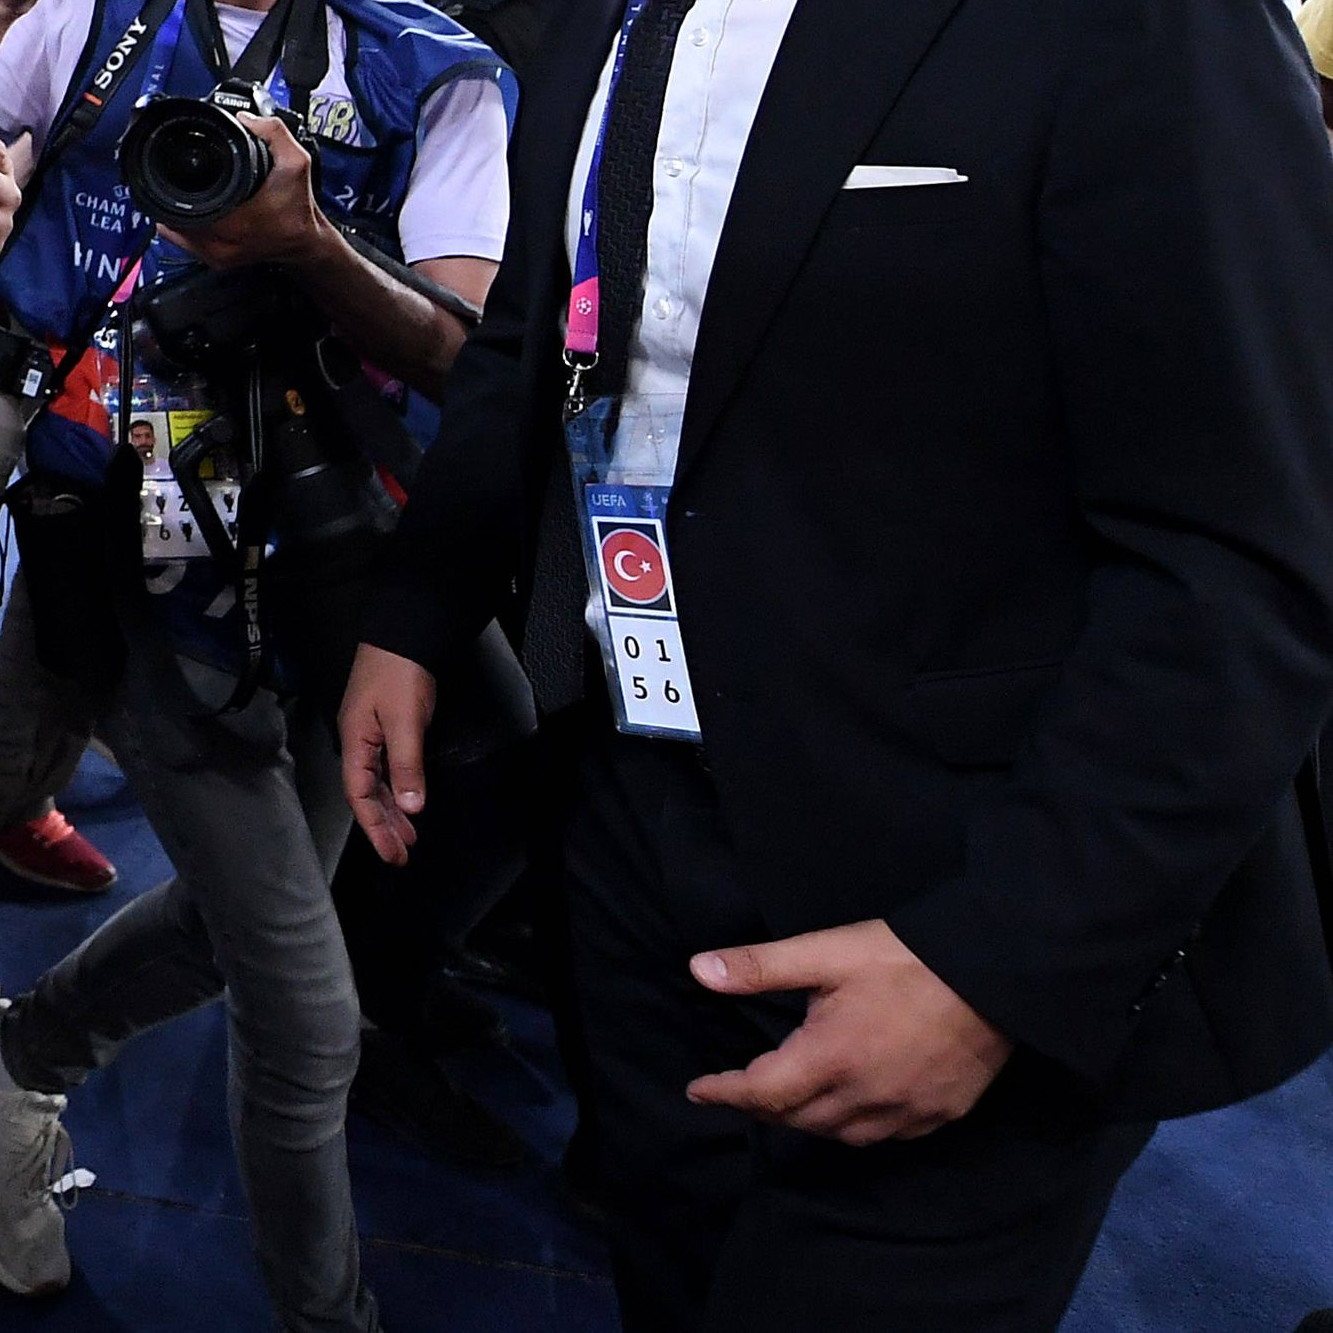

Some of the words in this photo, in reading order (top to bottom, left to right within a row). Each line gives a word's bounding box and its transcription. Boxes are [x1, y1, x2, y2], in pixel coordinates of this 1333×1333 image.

[93, 16, 148, 91] SONY
[214, 92, 252, 110] Canon
[90, 212, 123, 233] LEA
[591, 493, 627, 508] UEFA
[624, 635, 641, 660] 0
[655, 639, 672, 662] 1
[632, 676, 649, 700] 5
[664, 679, 681, 704] 6
